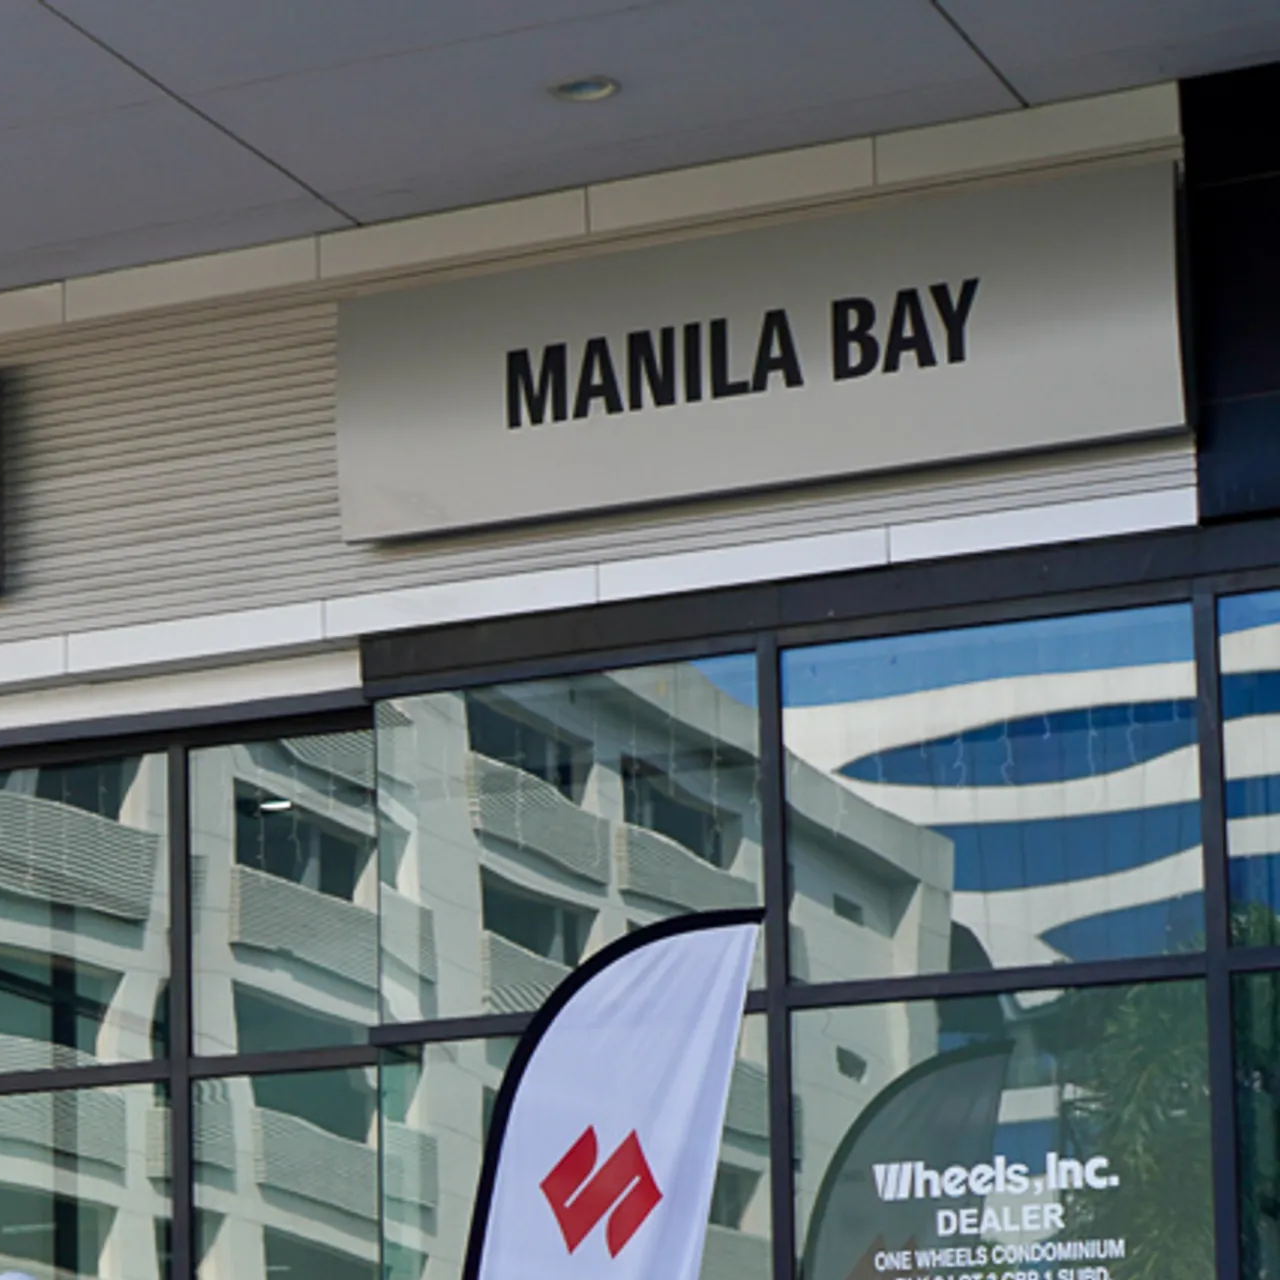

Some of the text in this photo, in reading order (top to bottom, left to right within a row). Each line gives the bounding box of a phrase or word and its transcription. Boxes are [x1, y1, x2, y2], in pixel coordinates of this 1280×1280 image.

[506, 277, 980, 429] MANILA BAY
[937, 1203, 1065, 1236] DEALER
[874, 1239, 1125, 1271] ONE WHEELS CONDOMINIUM
